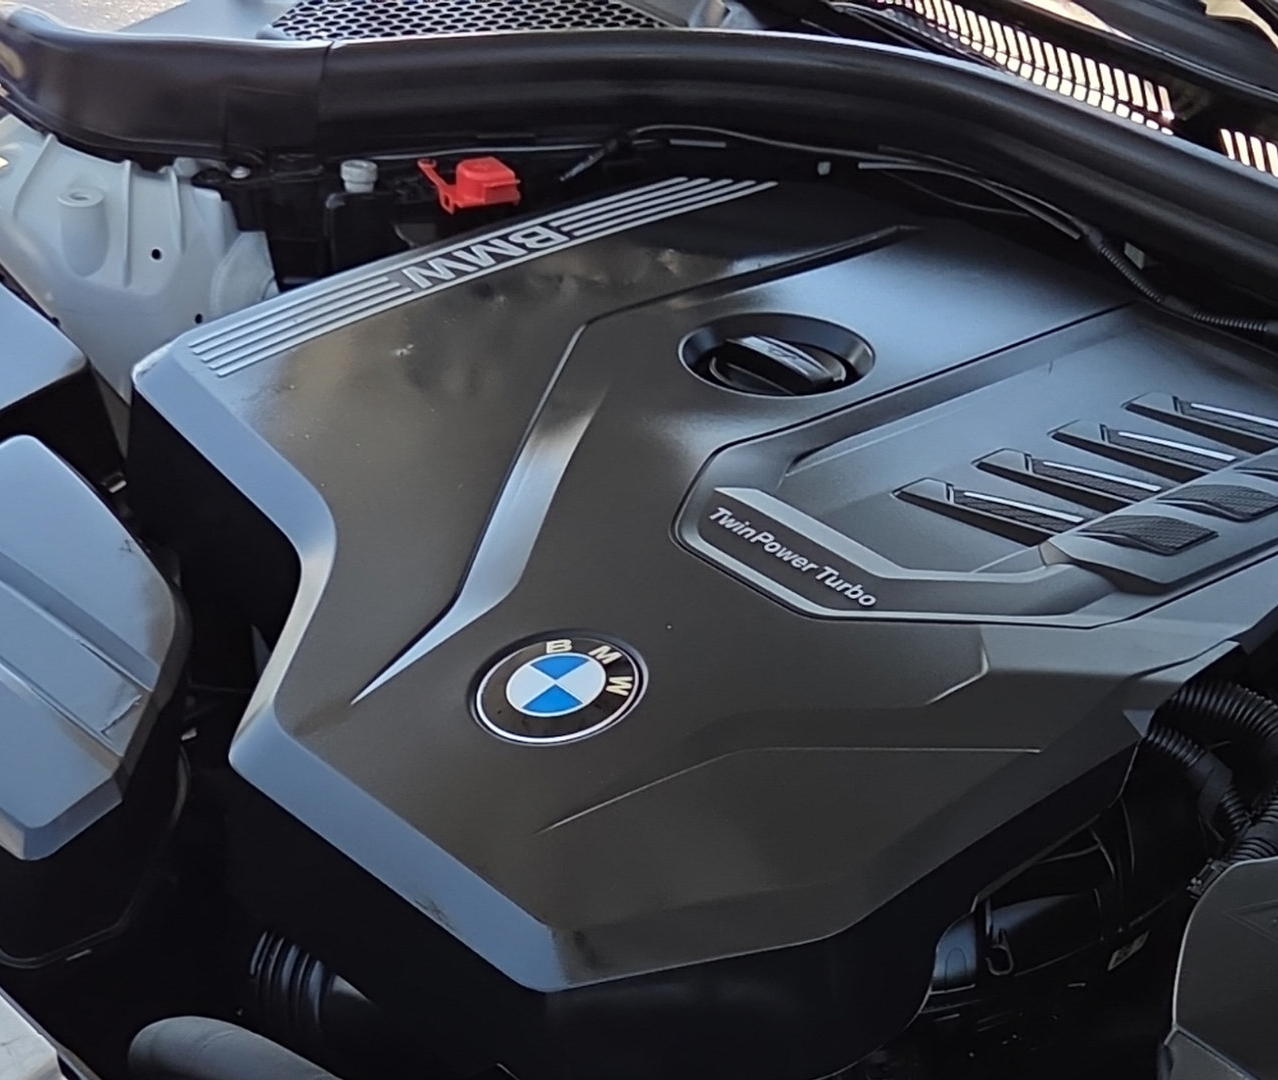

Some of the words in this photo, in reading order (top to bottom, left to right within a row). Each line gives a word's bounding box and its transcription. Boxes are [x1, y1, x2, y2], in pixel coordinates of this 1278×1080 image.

[402, 225, 570, 289] BMW
[709, 507, 818, 572] TwinPower
[815, 565, 877, 607] Turbo
[546, 639, 633, 697] BMW
